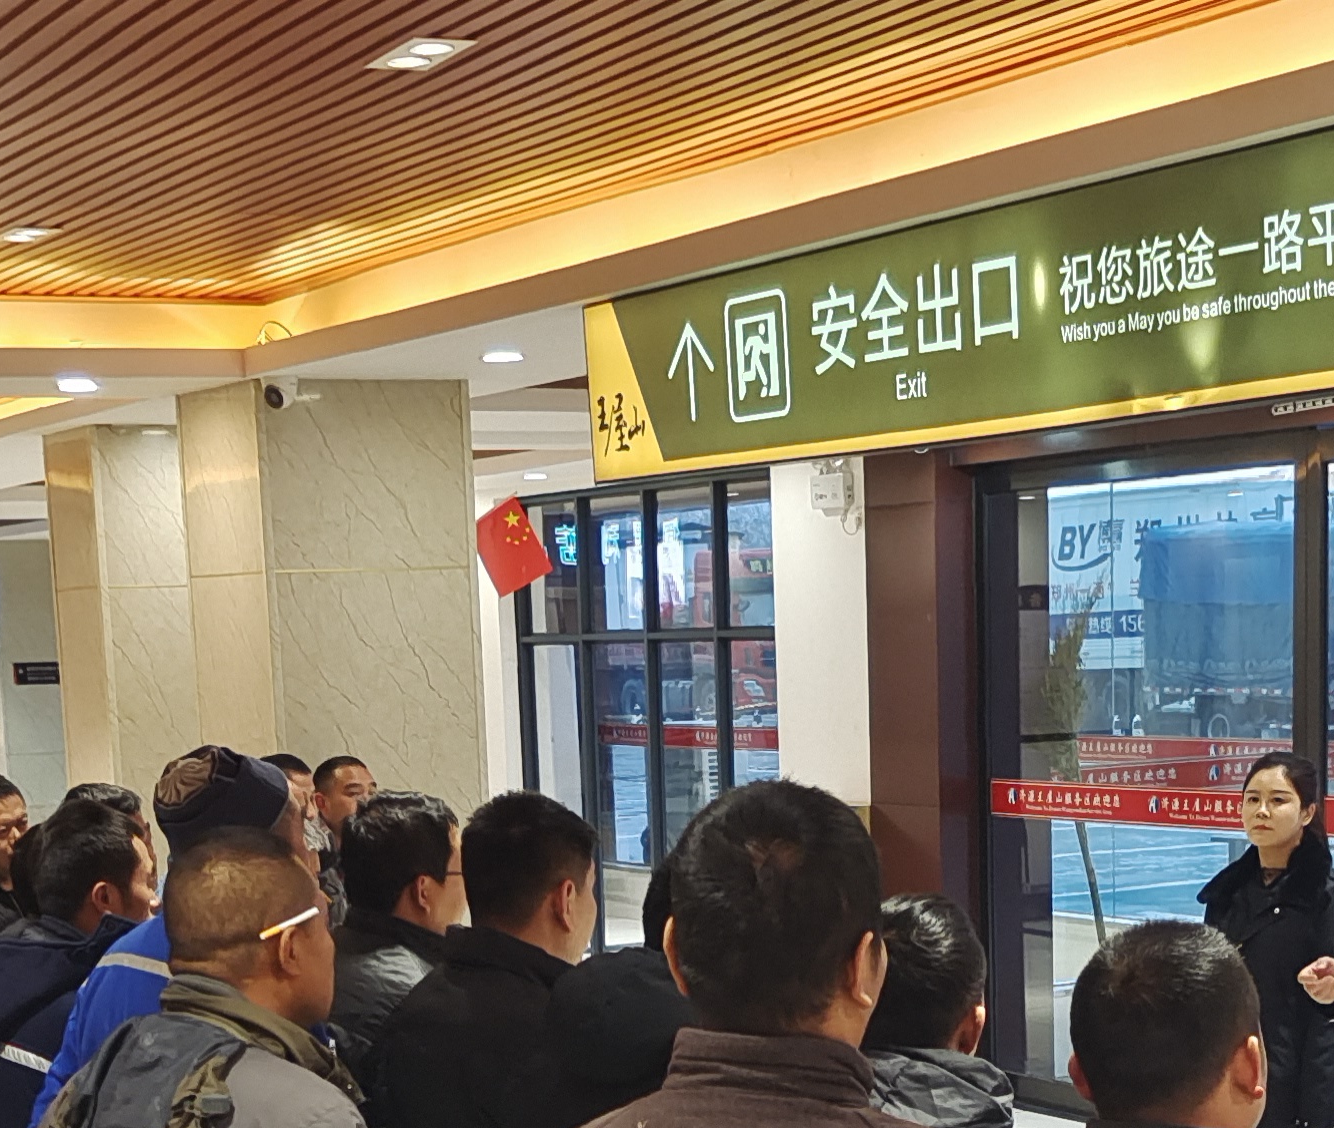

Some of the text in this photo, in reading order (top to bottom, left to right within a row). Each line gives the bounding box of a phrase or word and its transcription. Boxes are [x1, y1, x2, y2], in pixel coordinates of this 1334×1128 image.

[810, 255, 1020, 376] 安全出口
[1060, 322, 1091, 344] Wish
[1092, 318, 1116, 343] you
[1117, 319, 1126, 333] a
[1128, 311, 1155, 335] May
[1156, 307, 1181, 331] you
[1182, 299, 1200, 322] be
[1201, 295, 1232, 320] safe
[1234, 285, 1311, 314] throughout
[895, 370, 928, 401] Exit
[1057, 522, 1096, 562] BY
